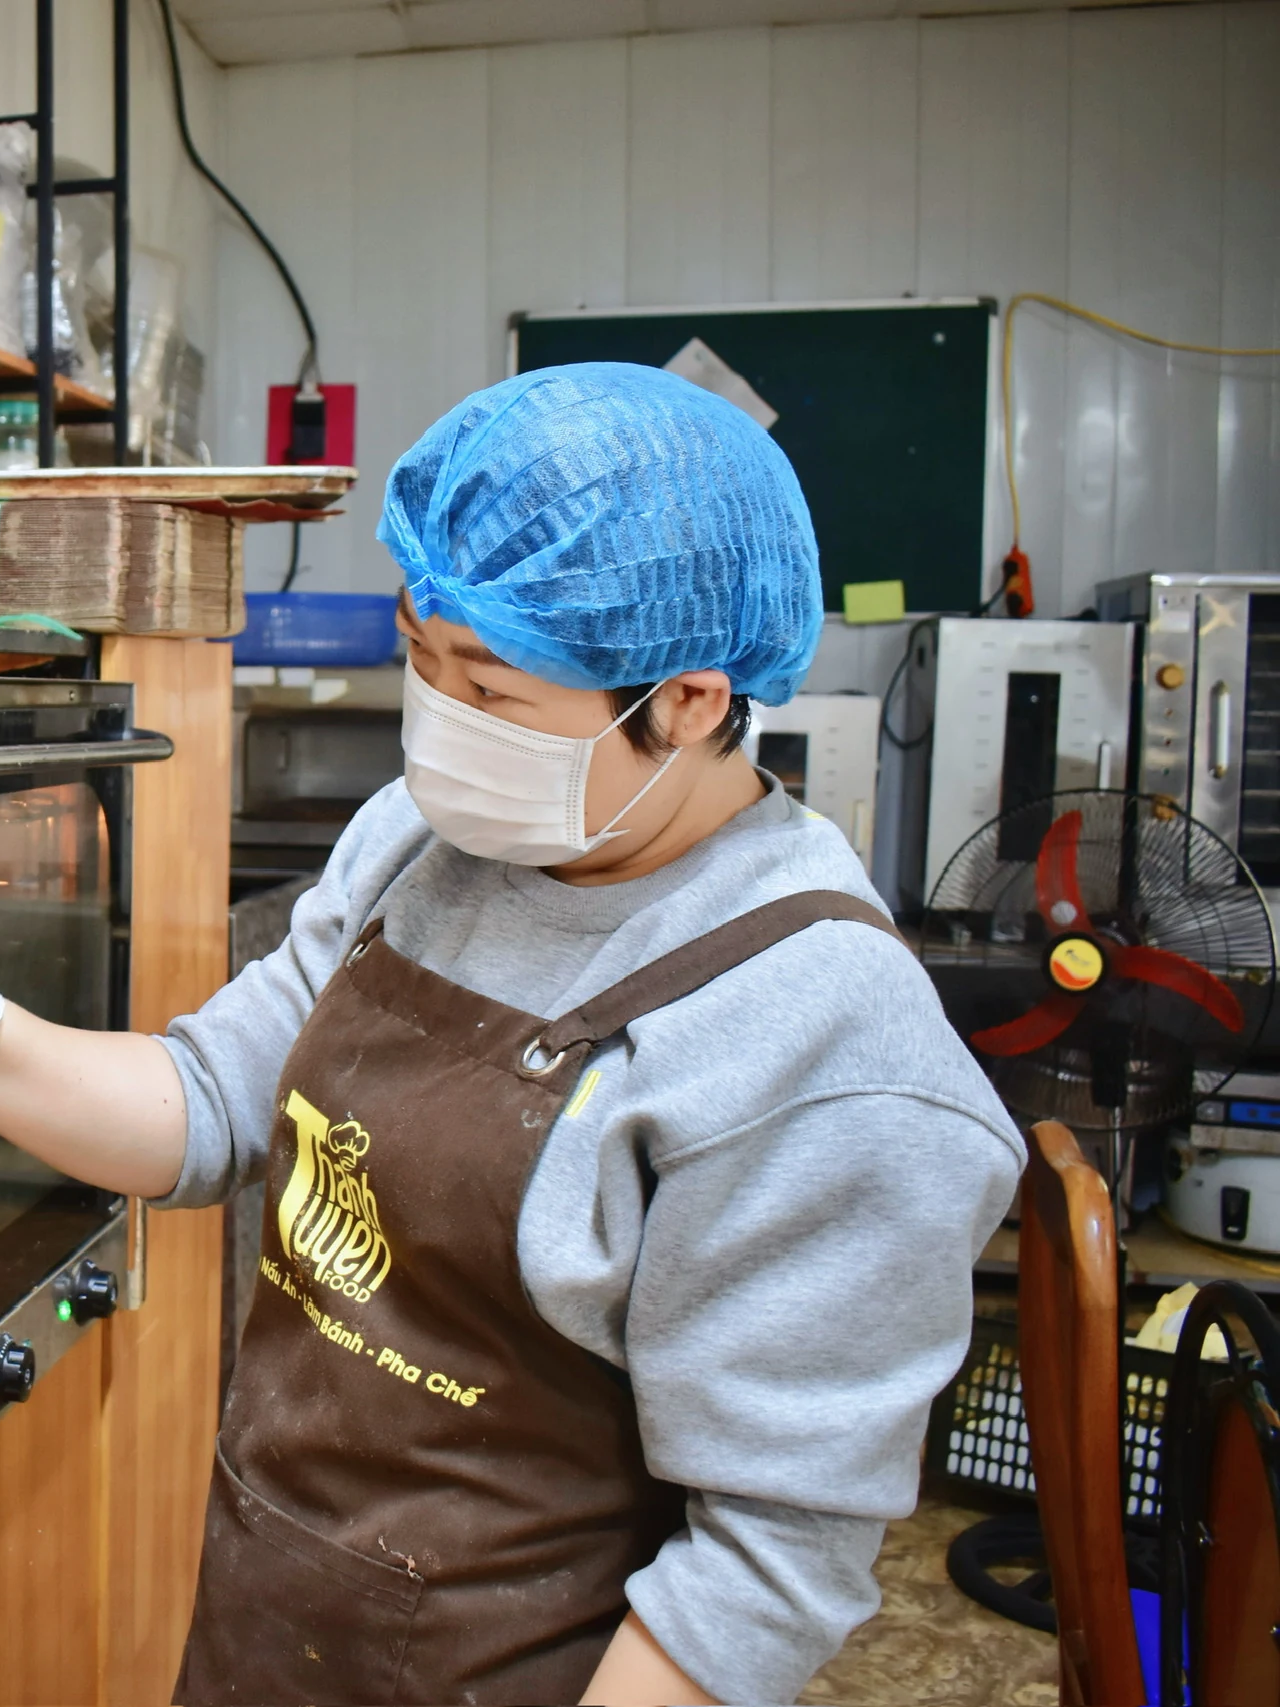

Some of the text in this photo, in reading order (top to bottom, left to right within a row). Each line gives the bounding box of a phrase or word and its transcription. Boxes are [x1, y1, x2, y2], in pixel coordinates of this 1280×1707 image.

[261, 1256, 281, 1286] Nấu
[303, 1297, 321, 1327] Làm
[320, 1314, 364, 1354] Bánh
[376, 1347, 422, 1384] Pha
[426, 1373, 486, 1408] Chế
[321, 1270, 371, 1303] FOOD
